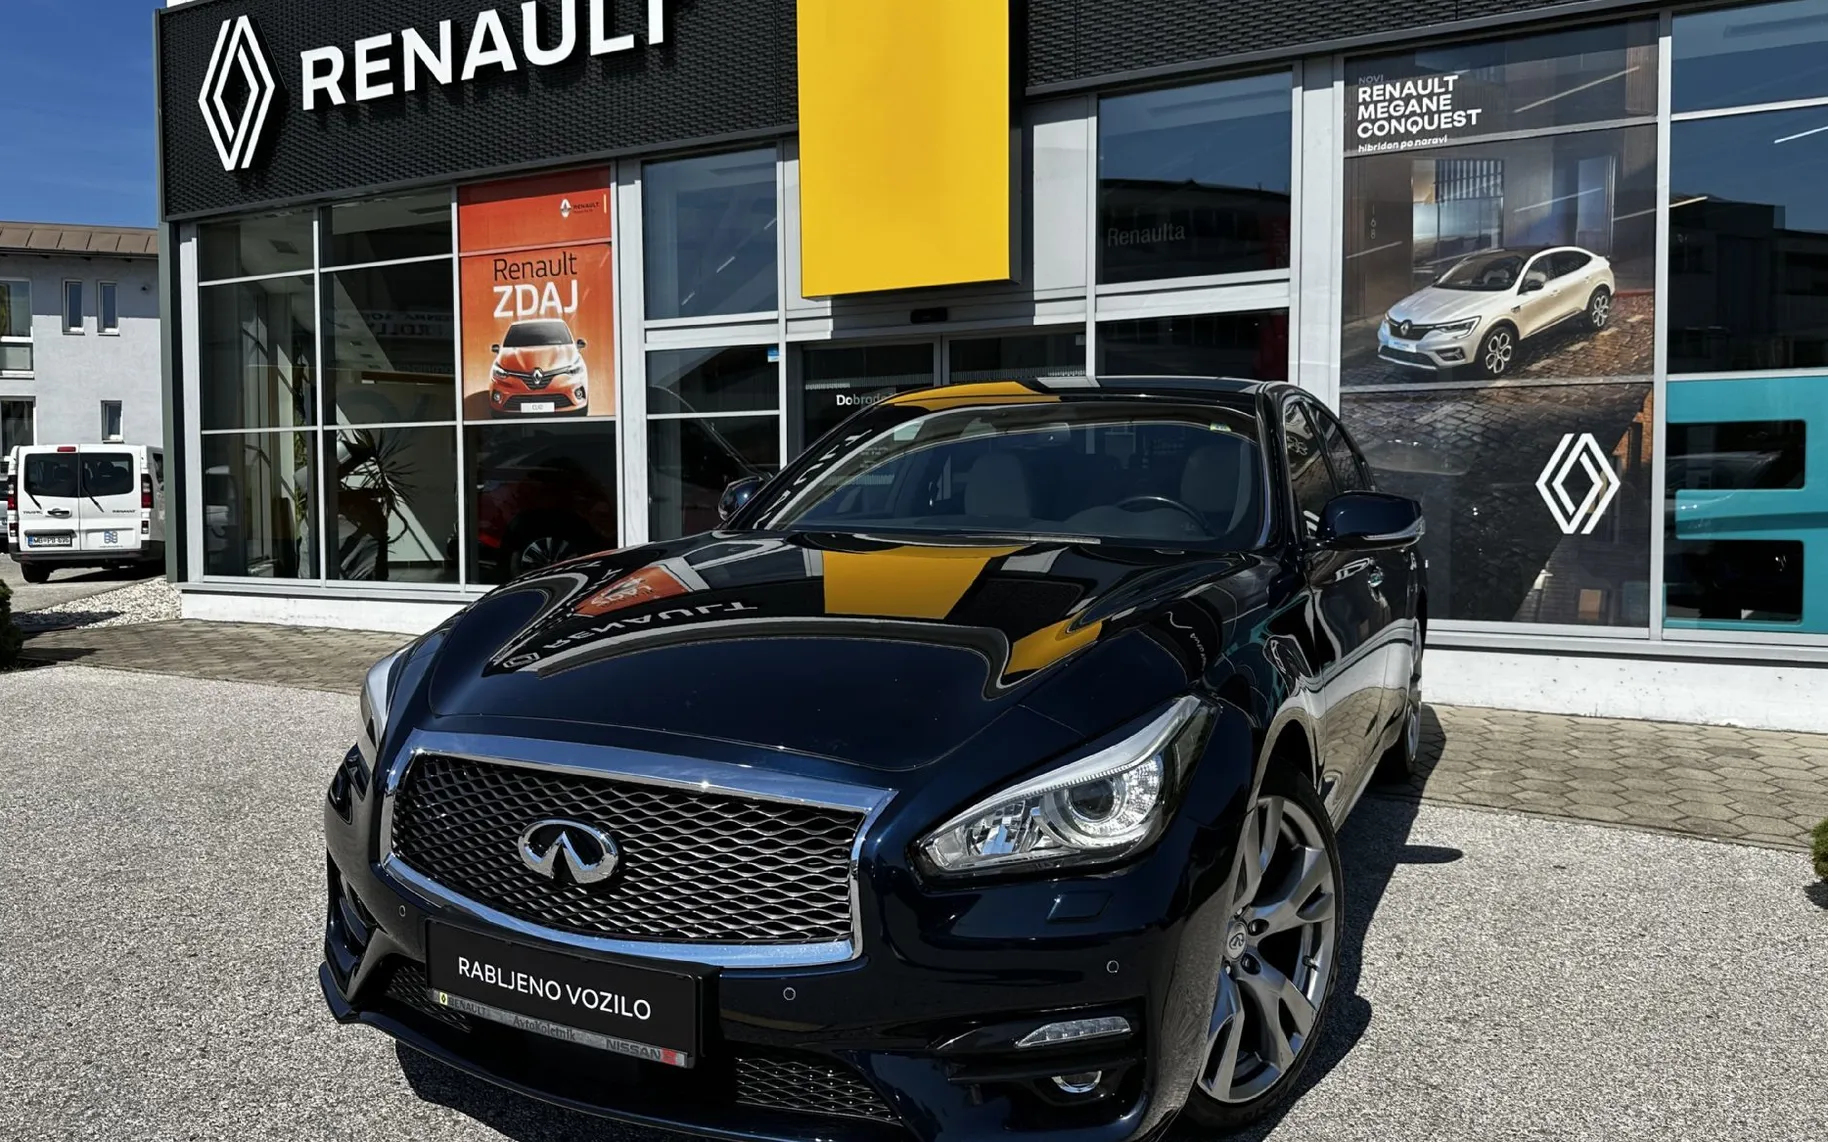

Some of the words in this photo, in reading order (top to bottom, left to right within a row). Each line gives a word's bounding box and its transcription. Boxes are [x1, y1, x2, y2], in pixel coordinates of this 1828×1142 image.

[1358, 74, 1384, 85] NOVI
[1358, 75, 1459, 103] RENAULT
[1357, 94, 1452, 120] MEGANE
[1357, 108, 1482, 138] CONQUEST
[1400, 139, 1414, 150] po
[1414, 134, 1448, 147] naravi
[1107, 222, 1186, 248] Renaulta
[493, 251, 577, 281] Renault
[493, 279, 578, 318] ZDAJ
[836, 393, 888, 406] Dobrod
[458, 956, 561, 1001] RABLJENO
[566, 983, 651, 1021] VOZILO
[606, 1038, 661, 1060] NISSAN
